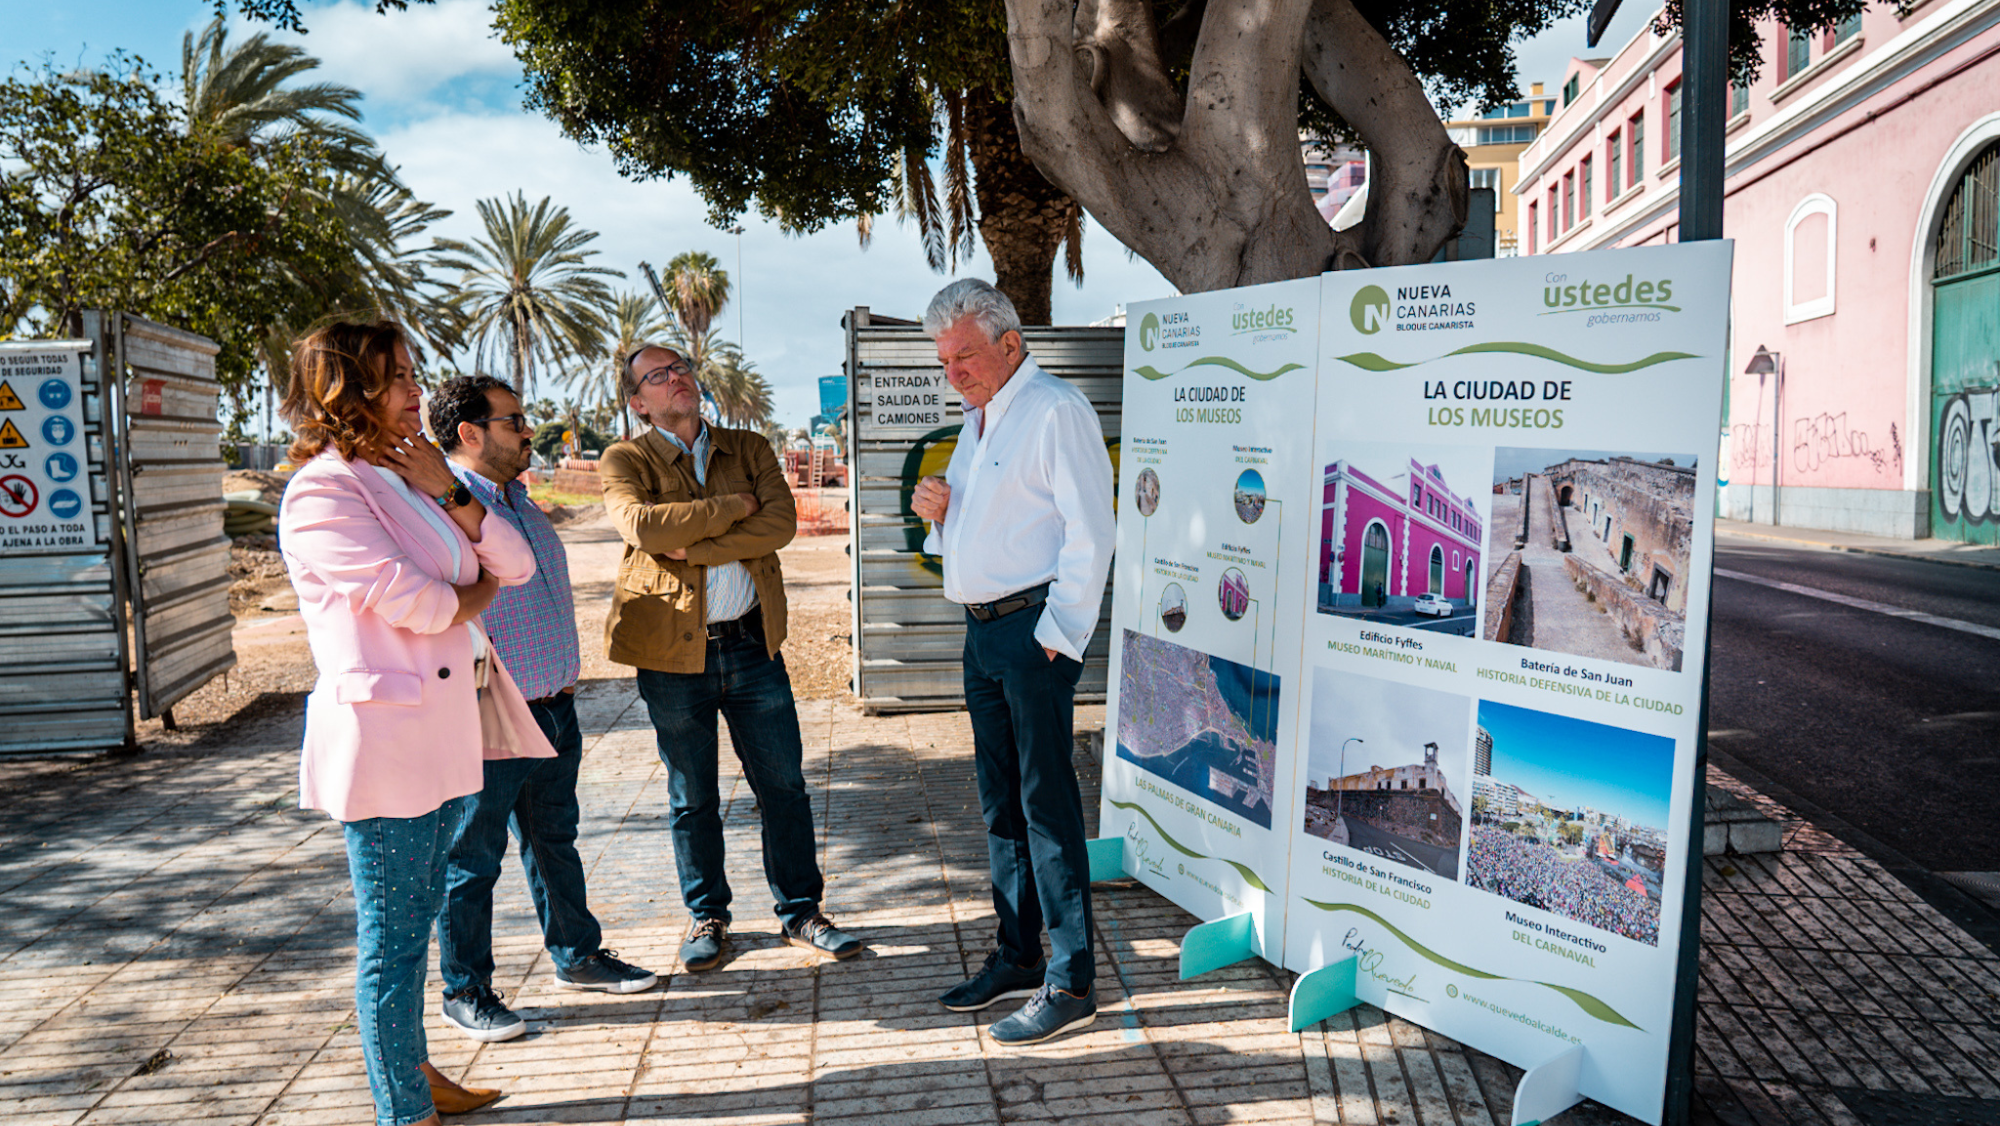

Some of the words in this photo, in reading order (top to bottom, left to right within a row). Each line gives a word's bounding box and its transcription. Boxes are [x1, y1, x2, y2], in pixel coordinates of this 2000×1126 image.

[1545, 271, 1567, 284] Con
[1397, 284, 1451, 301] NUEVA
[1543, 274, 1673, 308] ustedes
[1162, 312, 1189, 324] NUEVA
[1232, 304, 1293, 330] ustedes
[1396, 301, 1476, 319] CANARIAS
[1396, 322, 1427, 332] BLOQUE
[1428, 320, 1474, 331] CANARISTA
[1586, 311, 1661, 328] gobernamos
[1162, 326, 1201, 339] CANARIAS
[1252, 332, 1288, 345] gobernamos
[8, 355, 39, 365] SEGUIR
[41, 354, 69, 364] TODAS
[2, 367, 12, 377] DE
[15, 366, 63, 376] SEGURIDAD
[875, 376, 931, 388] ENTRADA
[933, 376, 941, 387] Y
[1424, 381, 1447, 400] LA
[1453, 380, 1535, 400] CIUDAD
[1542, 381, 1572, 401] DE
[878, 394, 921, 406] SALIDA
[923, 394, 939, 405] DE
[1174, 387, 1186, 402] LA
[1188, 386, 1228, 402] CIUDAD
[1231, 386, 1246, 402] DE
[878, 412, 940, 424] CAMIONES
[1176, 408, 1194, 423] LOS
[1197, 408, 1242, 424] MUSEOS
[1428, 406, 1464, 427] LOS
[1471, 407, 1564, 429] MUSEOS
[8, 525, 19, 534] EL
[23, 524, 47, 534] PASO
[51, 524, 57, 533] A
[60, 524, 85, 532] TODA
[2, 537, 32, 547] AJENA
[36, 537, 41, 546] A
[44, 537, 56, 546] LA
[59, 536, 84, 545] OBRA
[1360, 630, 1393, 645] Edificio
[1395, 636, 1423, 650] Fyffes
[1327, 640, 1361, 655] MUSEO
[1362, 644, 1414, 665] MARÍTIMO
[1416, 656, 1422, 666] Y
[1425, 657, 1458, 673] NAVAL
[1520, 658, 1560, 675] Batería
[1563, 664, 1578, 678] de
[1580, 668, 1602, 682] San
[1604, 672, 1633, 688] Juan
[1476, 667, 1527, 686] HISTORIA
[1530, 677, 1592, 699] DEFENSIVA
[1595, 689, 1611, 703] DE
[1614, 692, 1630, 706] LA
[1633, 696, 1684, 716] CIUDAD
[1135, 776, 1147, 790] LAS
[1147, 780, 1174, 803] PALMAS
[1175, 795, 1184, 809] DE
[1185, 801, 1207, 821] GRAN
[1207, 813, 1242, 839] CANARIA
[1322, 850, 1354, 869] Castillo
[1356, 861, 1368, 873] de
[1369, 865, 1387, 879] San
[1388, 870, 1432, 895] Francisco
[1322, 865, 1363, 887] HISTORIA
[1365, 879, 1377, 892] DE
[1379, 884, 1391, 897] LA
[1393, 889, 1431, 910] CIUDAD
[1505, 910, 1542, 932] Museo
[1545, 924, 1607, 954] Interactivo
[1512, 930, 1533, 946] DEL
[1535, 937, 1596, 969] CARNAVAL
